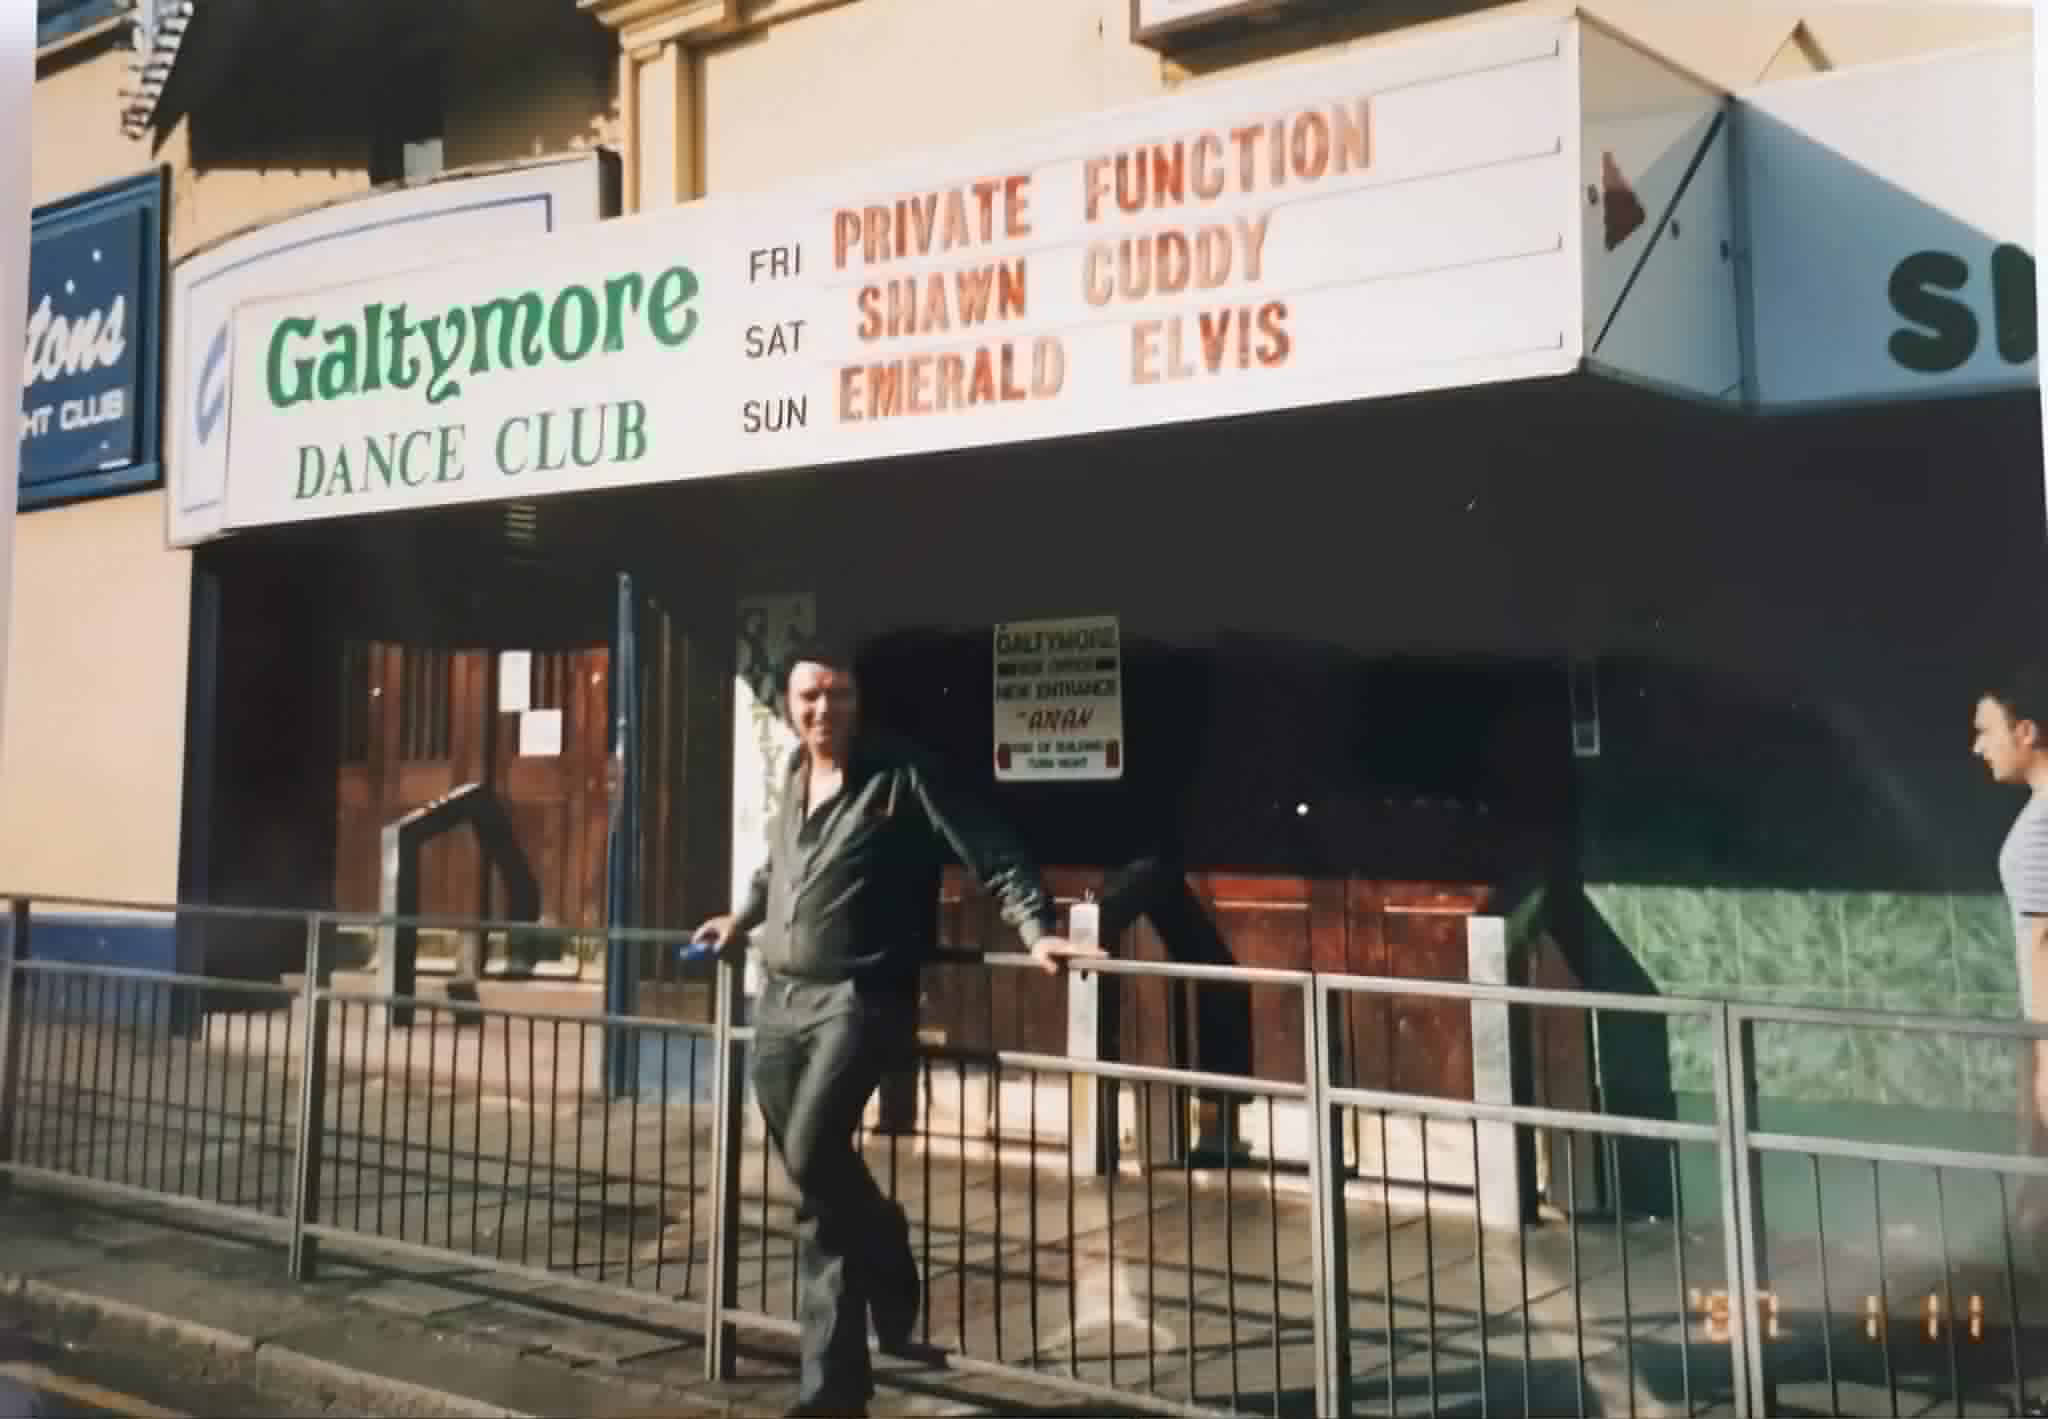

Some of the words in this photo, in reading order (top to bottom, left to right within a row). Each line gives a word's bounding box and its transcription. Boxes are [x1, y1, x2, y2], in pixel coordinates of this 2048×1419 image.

[750, 243, 801, 283] FRI
[833, 174, 1032, 270] PRIVATE
[1084, 100, 1372, 221] FUNCTION
[266, 265, 699, 405] Galtymore
[745, 320, 806, 359] SAT
[857, 261, 1026, 341] SHAWN
[1084, 214, 1271, 306] CUDDY
[60, 388, 125, 431] CLUB
[743, 394, 808, 433] SUN
[839, 335, 1065, 424] EMERALD
[1130, 302, 1291, 384] ELVIS
[294, 423, 466, 501] DANCE
[495, 399, 649, 476] CLUB
